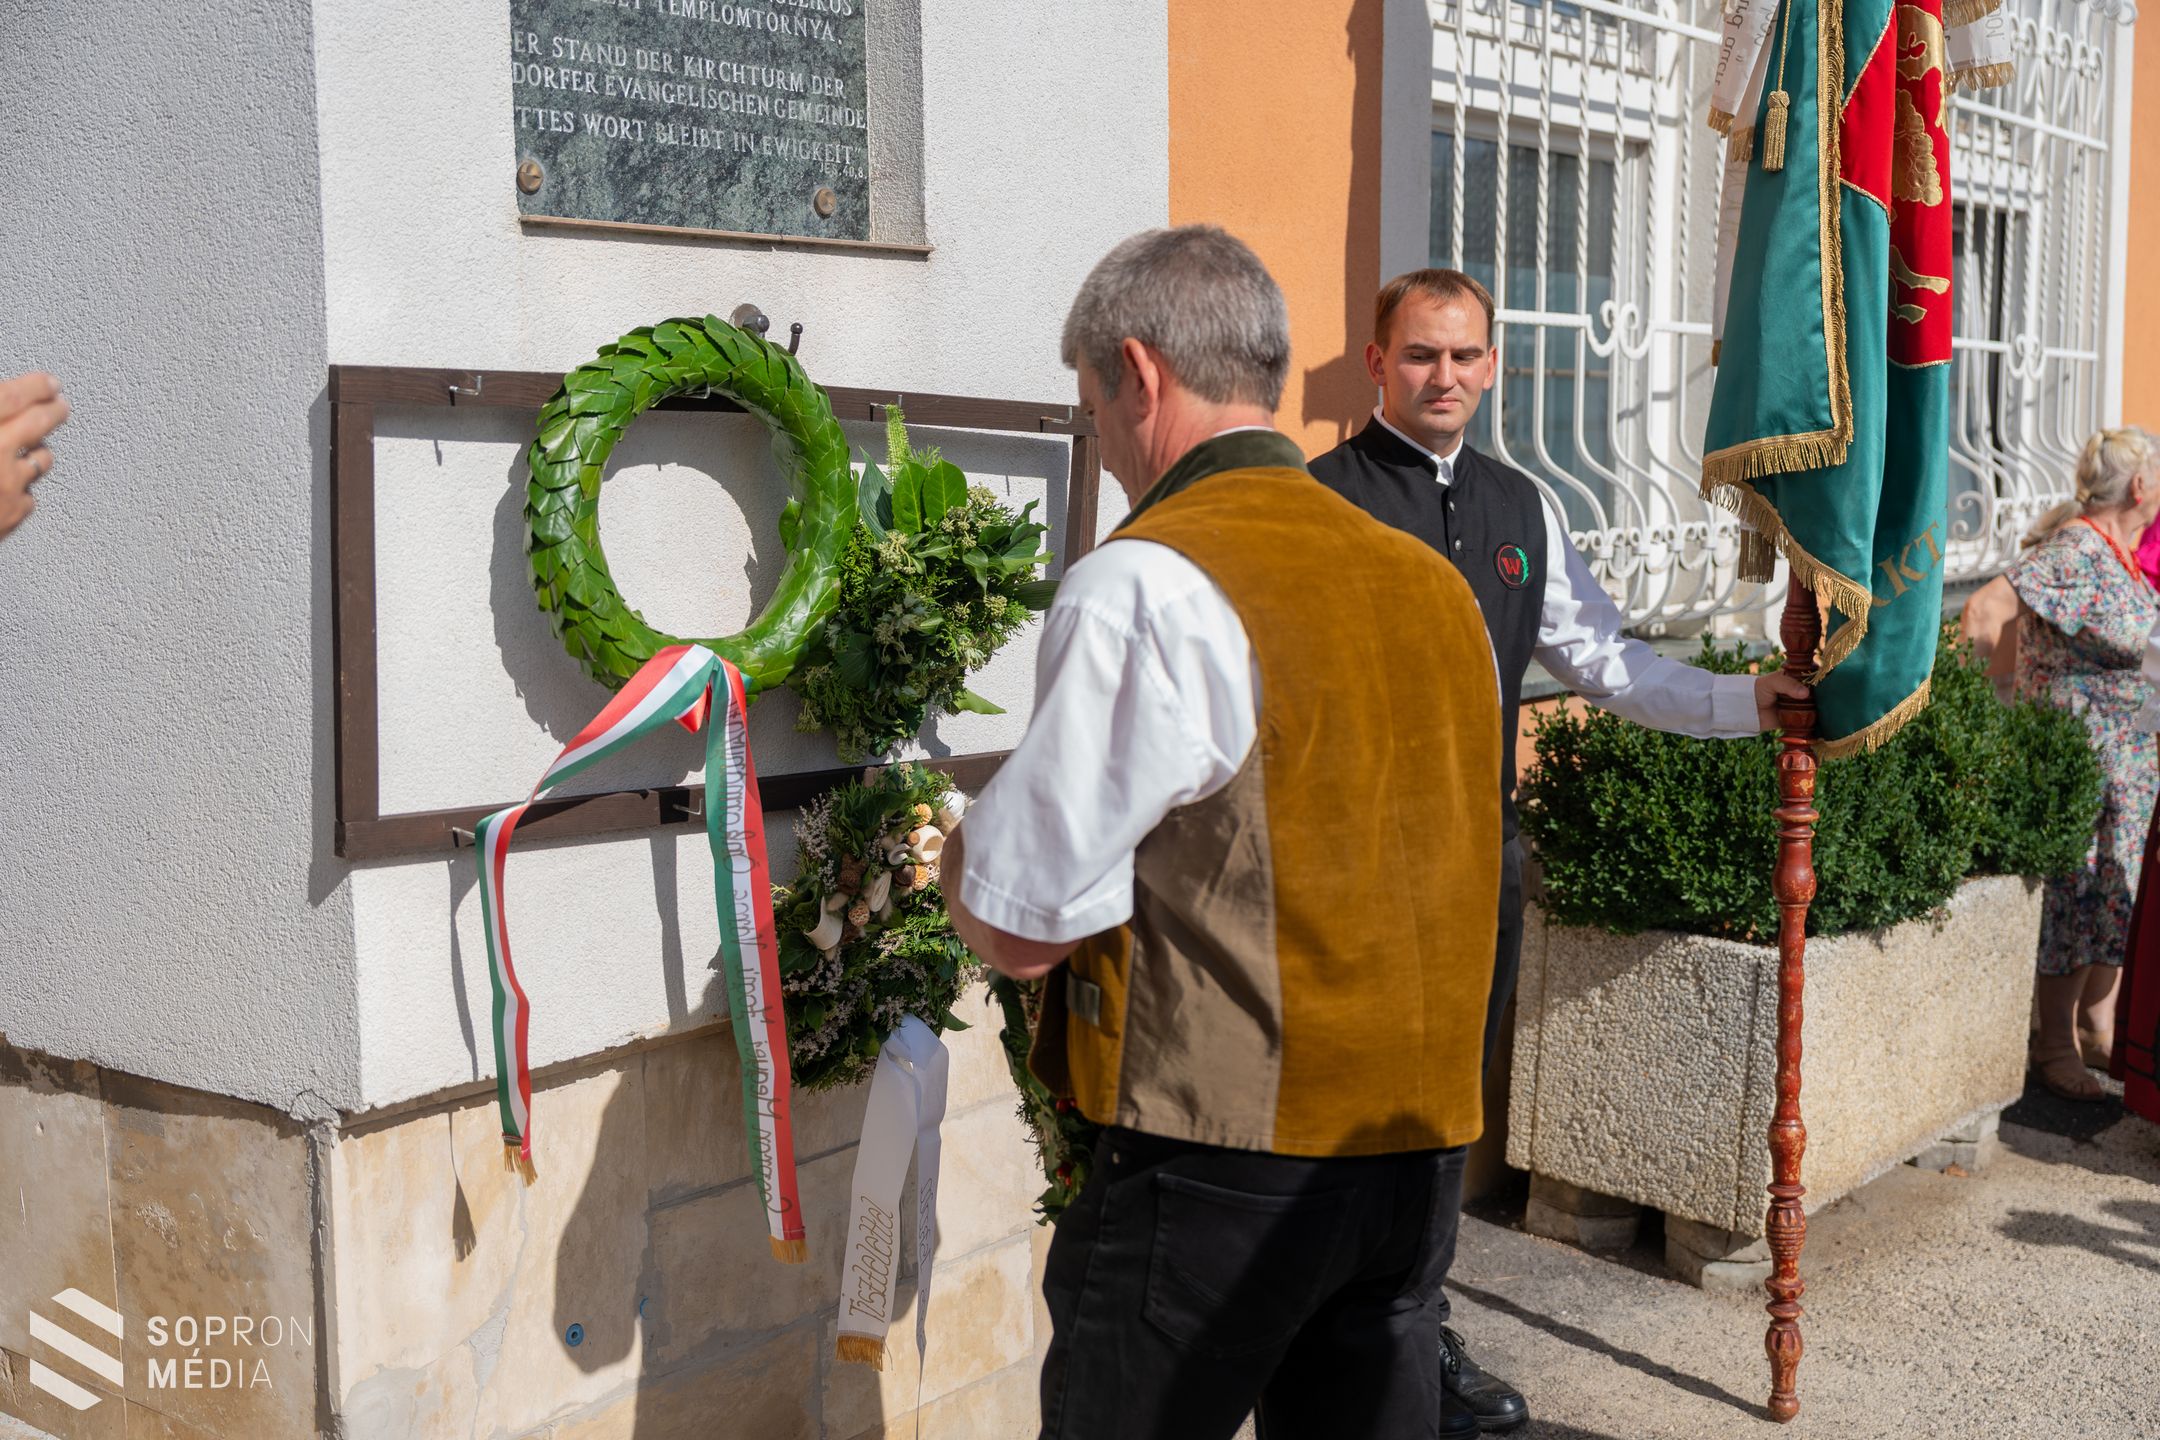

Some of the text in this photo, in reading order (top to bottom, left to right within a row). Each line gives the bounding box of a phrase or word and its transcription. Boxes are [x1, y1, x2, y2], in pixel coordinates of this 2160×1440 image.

[512, 61, 867, 129] DORFER EVANGELISCHEN GEMEINDE
[552, 36, 627, 67] STAND
[636, 49, 678, 74] DER
[683, 54, 804, 93] KIRCHTURM
[811, 74, 847, 99] DER
[583, 112, 647, 141] WORT
[655, 120, 725, 149] BLEIBT
[733, 131, 754, 152] IN
[1501, 557, 1521, 575] W
[1872, 520, 1943, 608] KT
[848, 1195, 894, 1323] Tisztelettel
